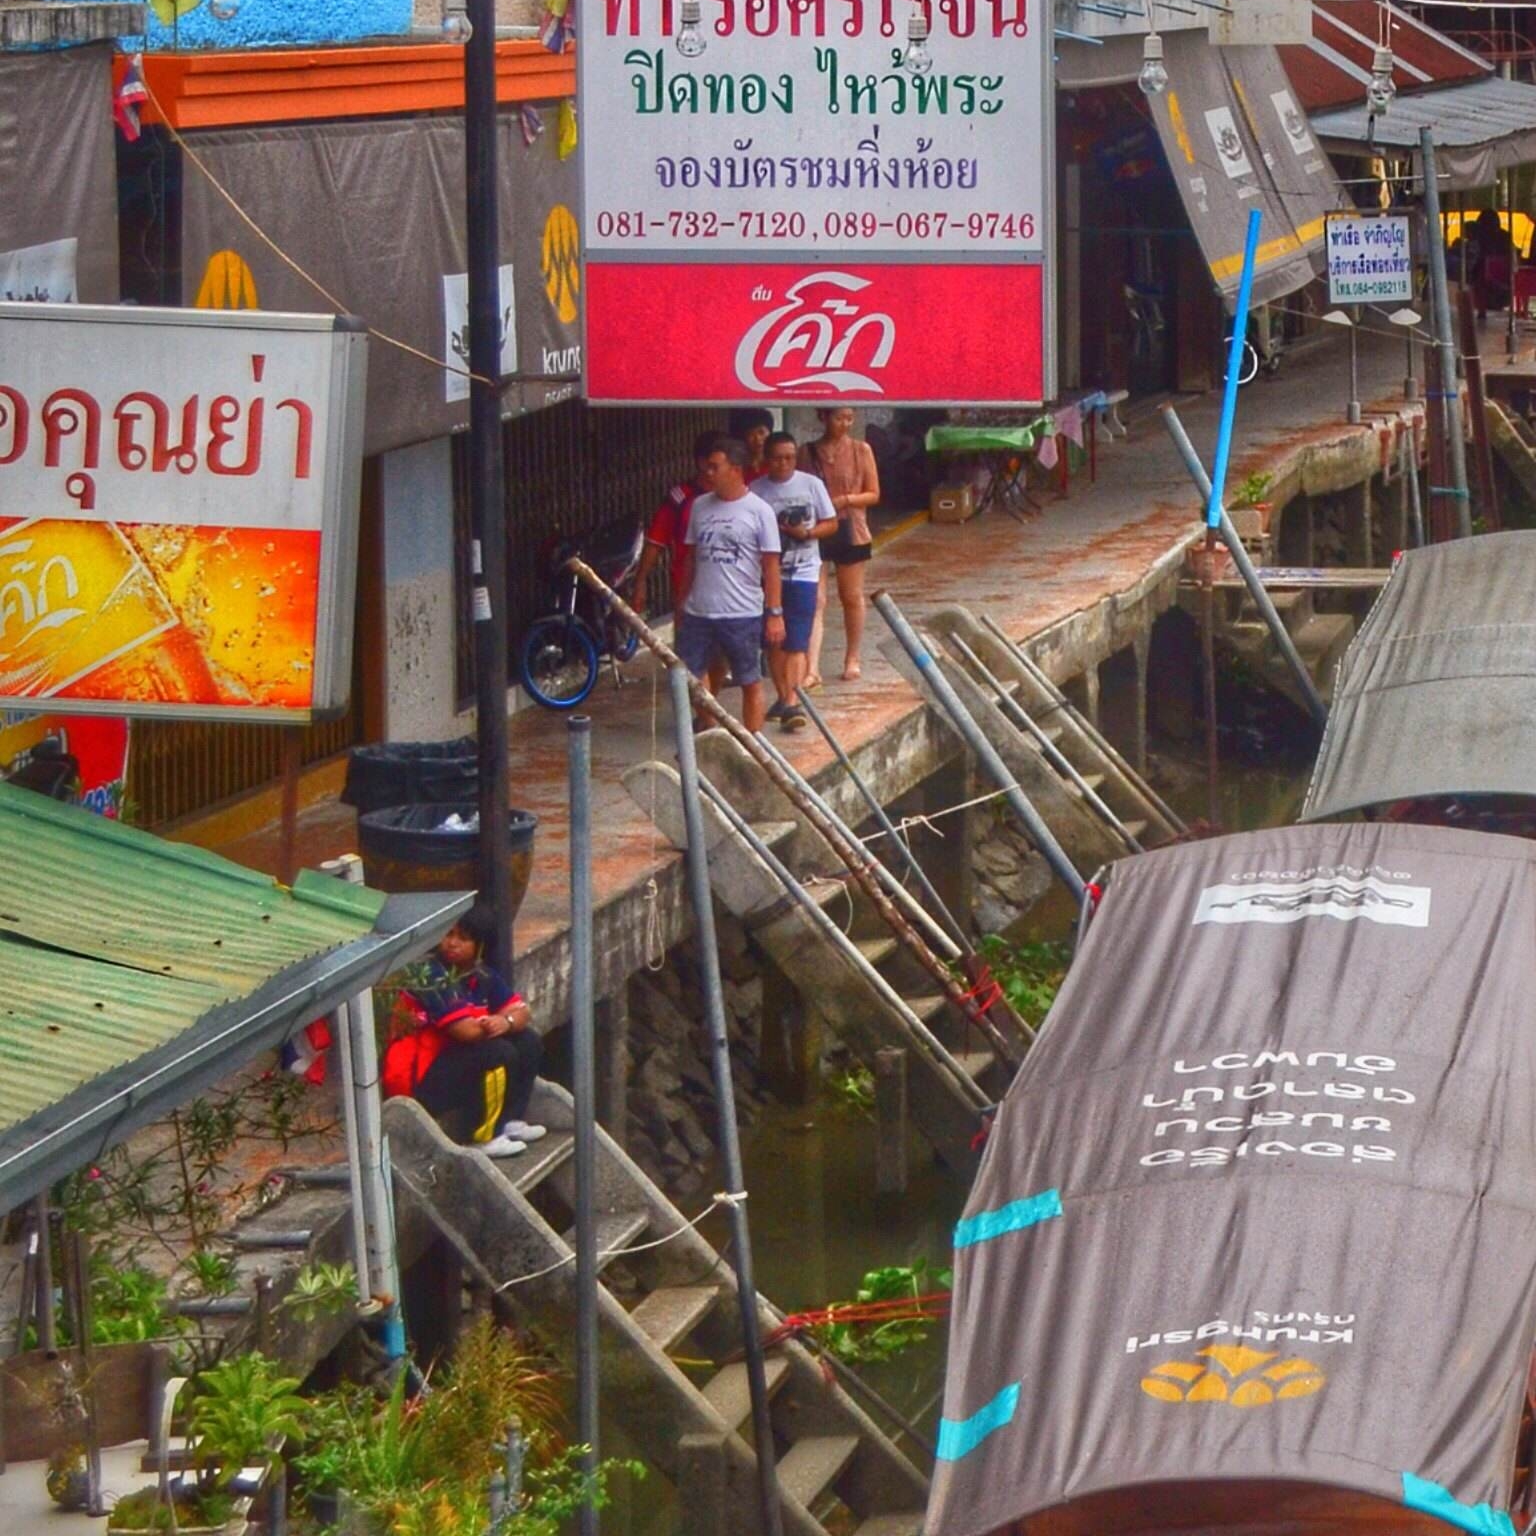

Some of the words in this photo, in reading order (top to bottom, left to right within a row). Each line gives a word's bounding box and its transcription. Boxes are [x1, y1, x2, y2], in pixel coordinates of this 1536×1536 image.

[624, 49, 793, 114] ปิดทอง
[815, 45, 1004, 114] ไหว้พระ
[655, 124, 977, 189] จองบัตรชมหิ่งห้อย
[1173, 1051, 1397, 1075] อัมพวา
[1142, 1080, 1416, 1111] ตลาดน้ำ
[1154, 1111, 1391, 1136] ชมสวน
[1139, 1141, 1397, 1168] ล่องเรือ
